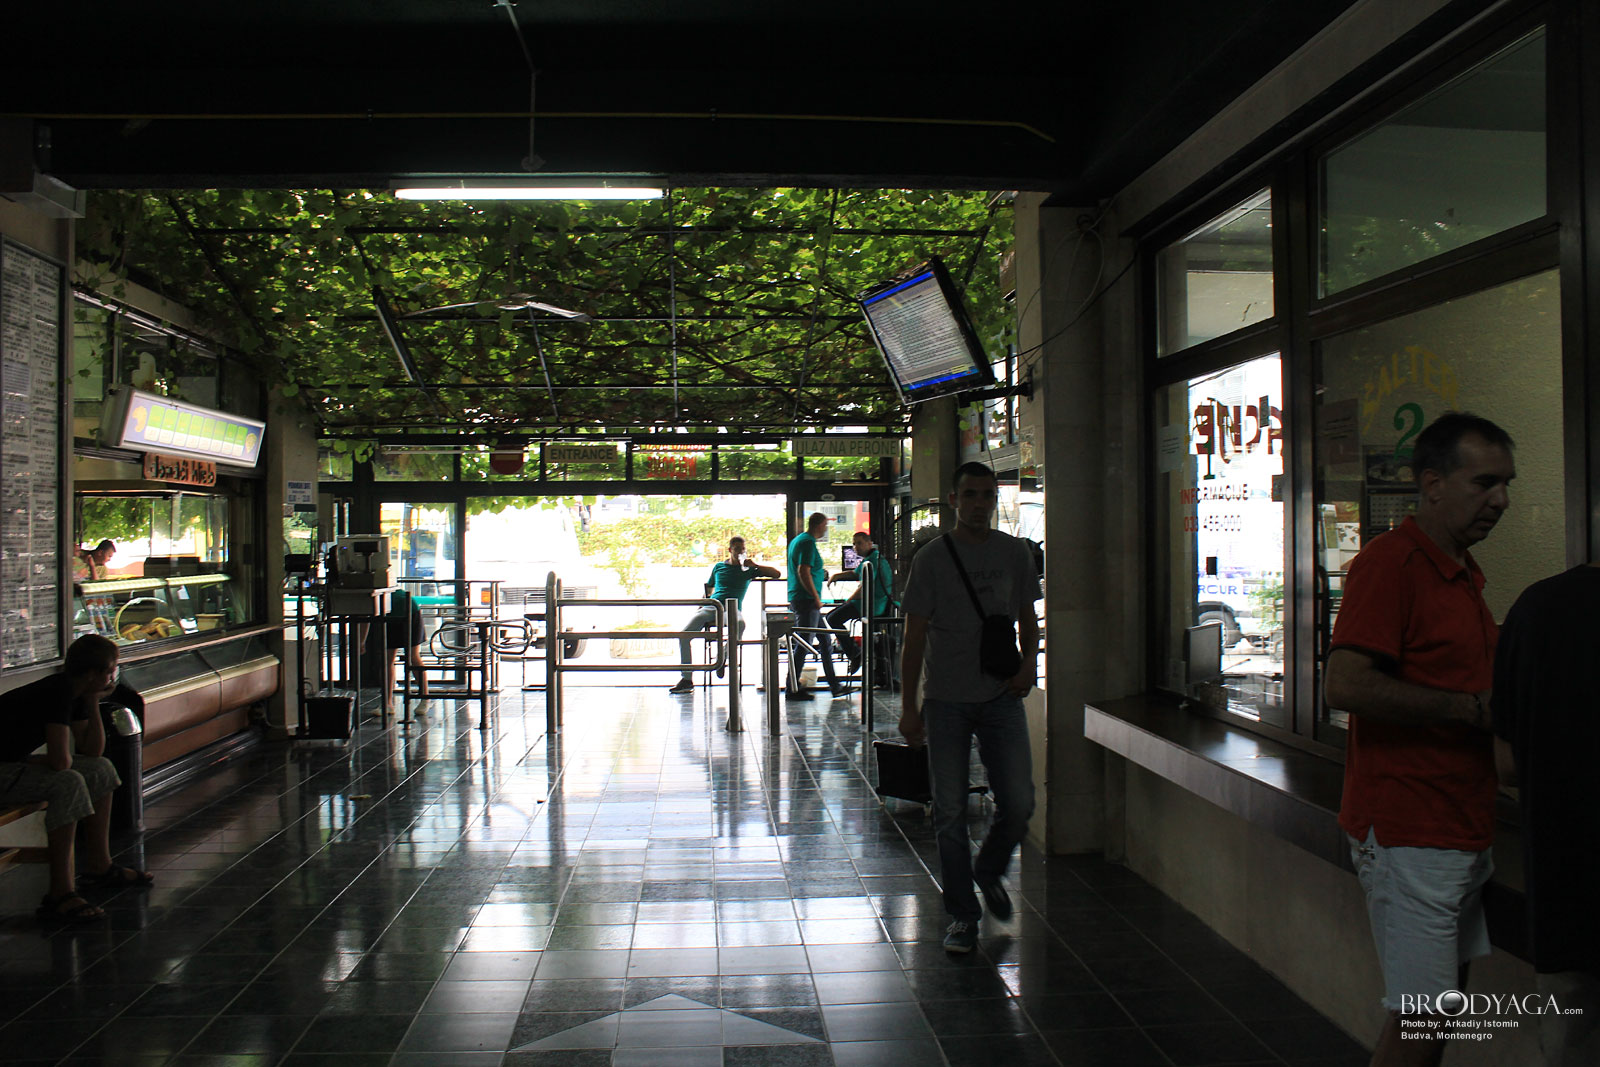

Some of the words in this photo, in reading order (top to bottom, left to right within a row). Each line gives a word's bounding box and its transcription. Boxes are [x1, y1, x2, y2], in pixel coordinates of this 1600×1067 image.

[1394, 402, 1425, 461] 2
[550, 448, 613, 460] ENTRANCE
[795, 440, 826, 455] ULAZ
[829, 440, 847, 455] NA
[849, 440, 897, 455] PERONE
